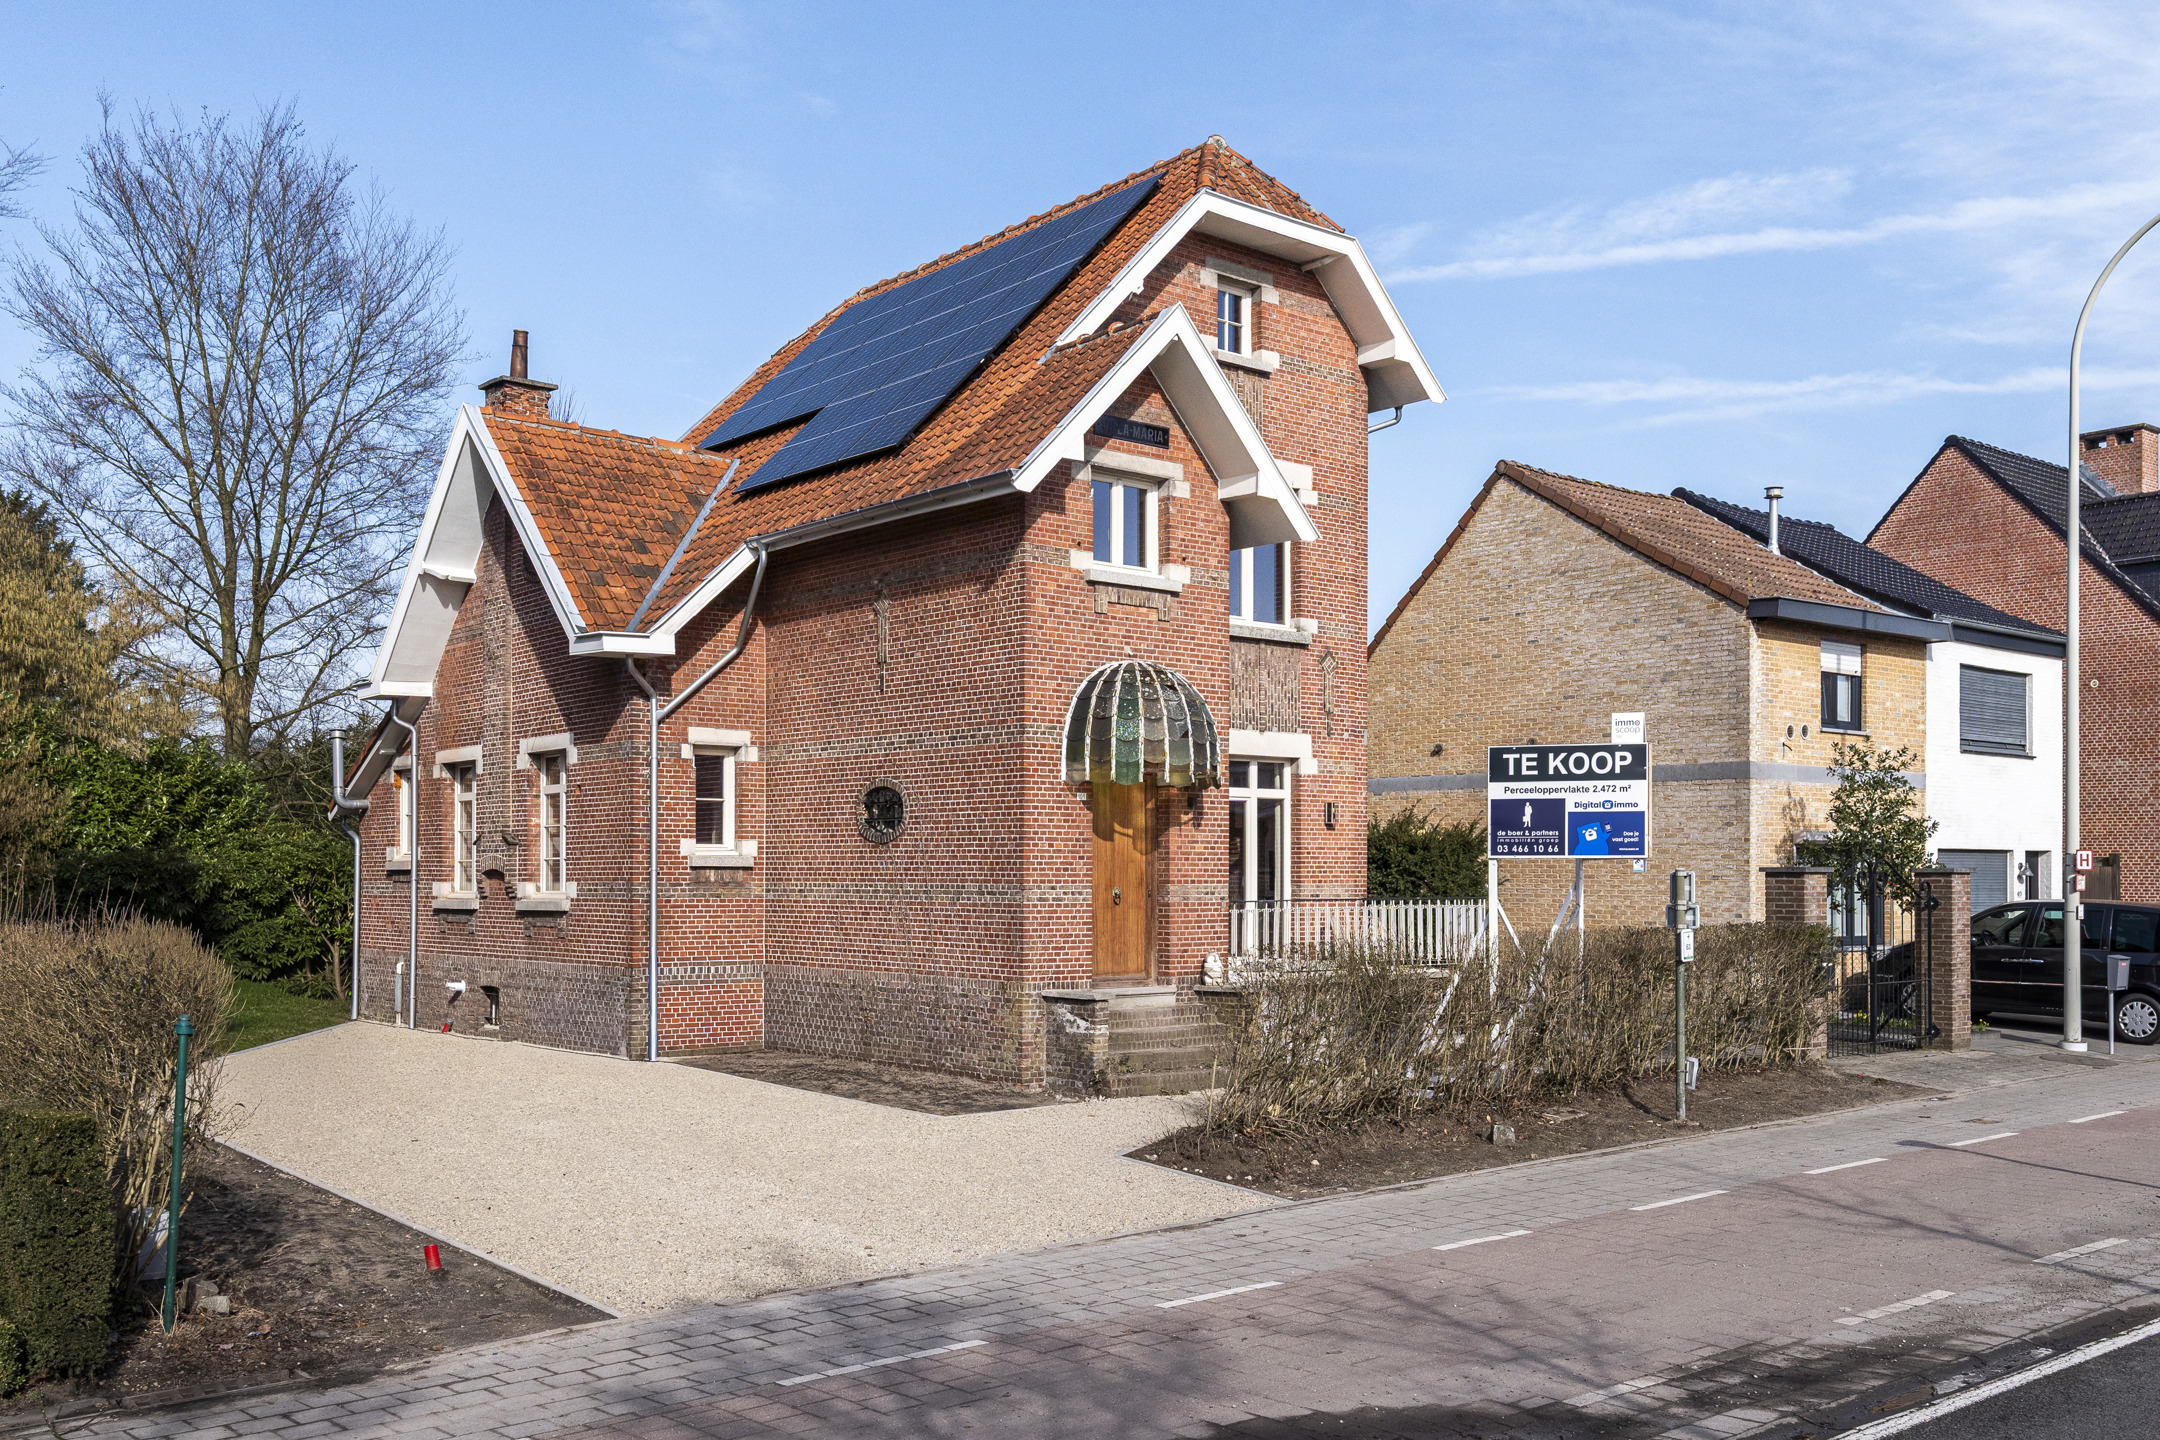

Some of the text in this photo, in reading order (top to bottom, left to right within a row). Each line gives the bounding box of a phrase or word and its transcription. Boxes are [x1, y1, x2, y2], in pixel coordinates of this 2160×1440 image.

[1615, 718, 1640, 726] immo
[1502, 751, 1632, 776] TE KOOP
[1504, 785, 1632, 795] Perceeloppervlakte 2.472 m²
[1574, 801, 1639, 810] Digital immo
[1497, 845, 1559, 853] 03 466 10 66
[2080, 853, 2090, 867] H
